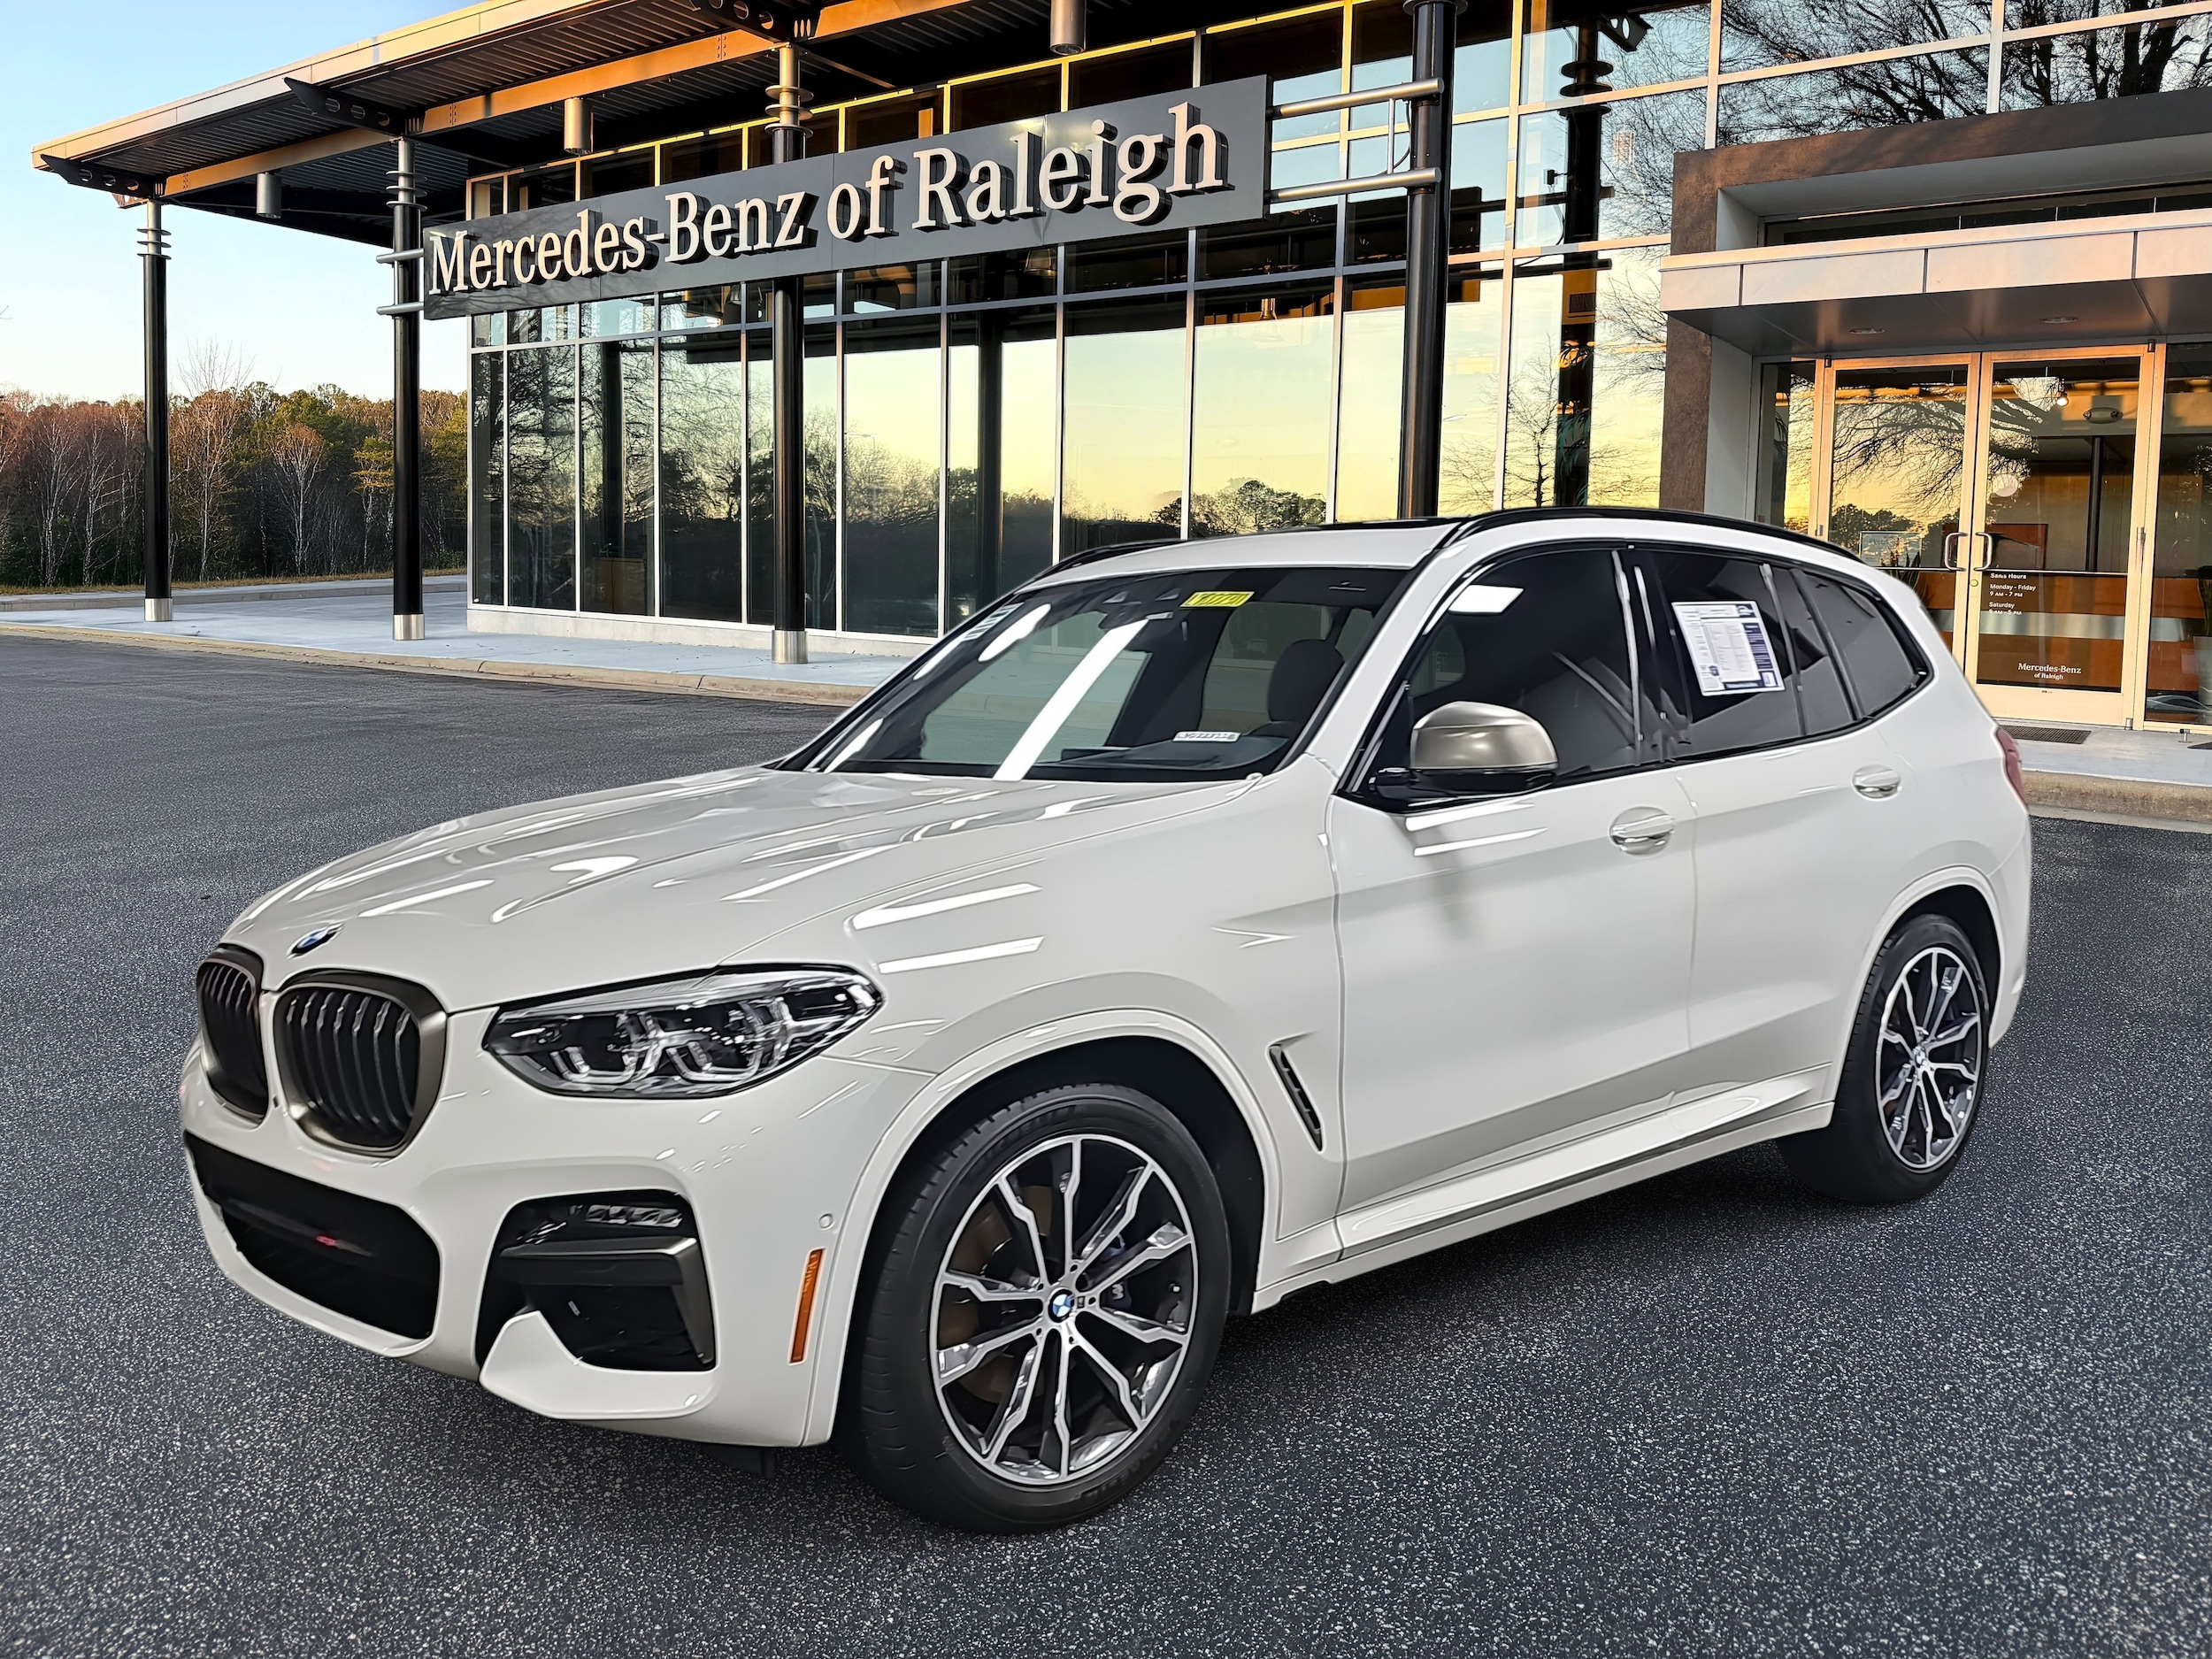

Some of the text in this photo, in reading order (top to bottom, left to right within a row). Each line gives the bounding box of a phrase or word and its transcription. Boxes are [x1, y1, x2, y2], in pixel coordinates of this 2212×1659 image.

[428, 101, 1228, 296] Mercedes-Benz of Raleigh
[1988, 601, 2016, 610] Saturday
[2017, 662, 2082, 674] Mercedes-Benz
